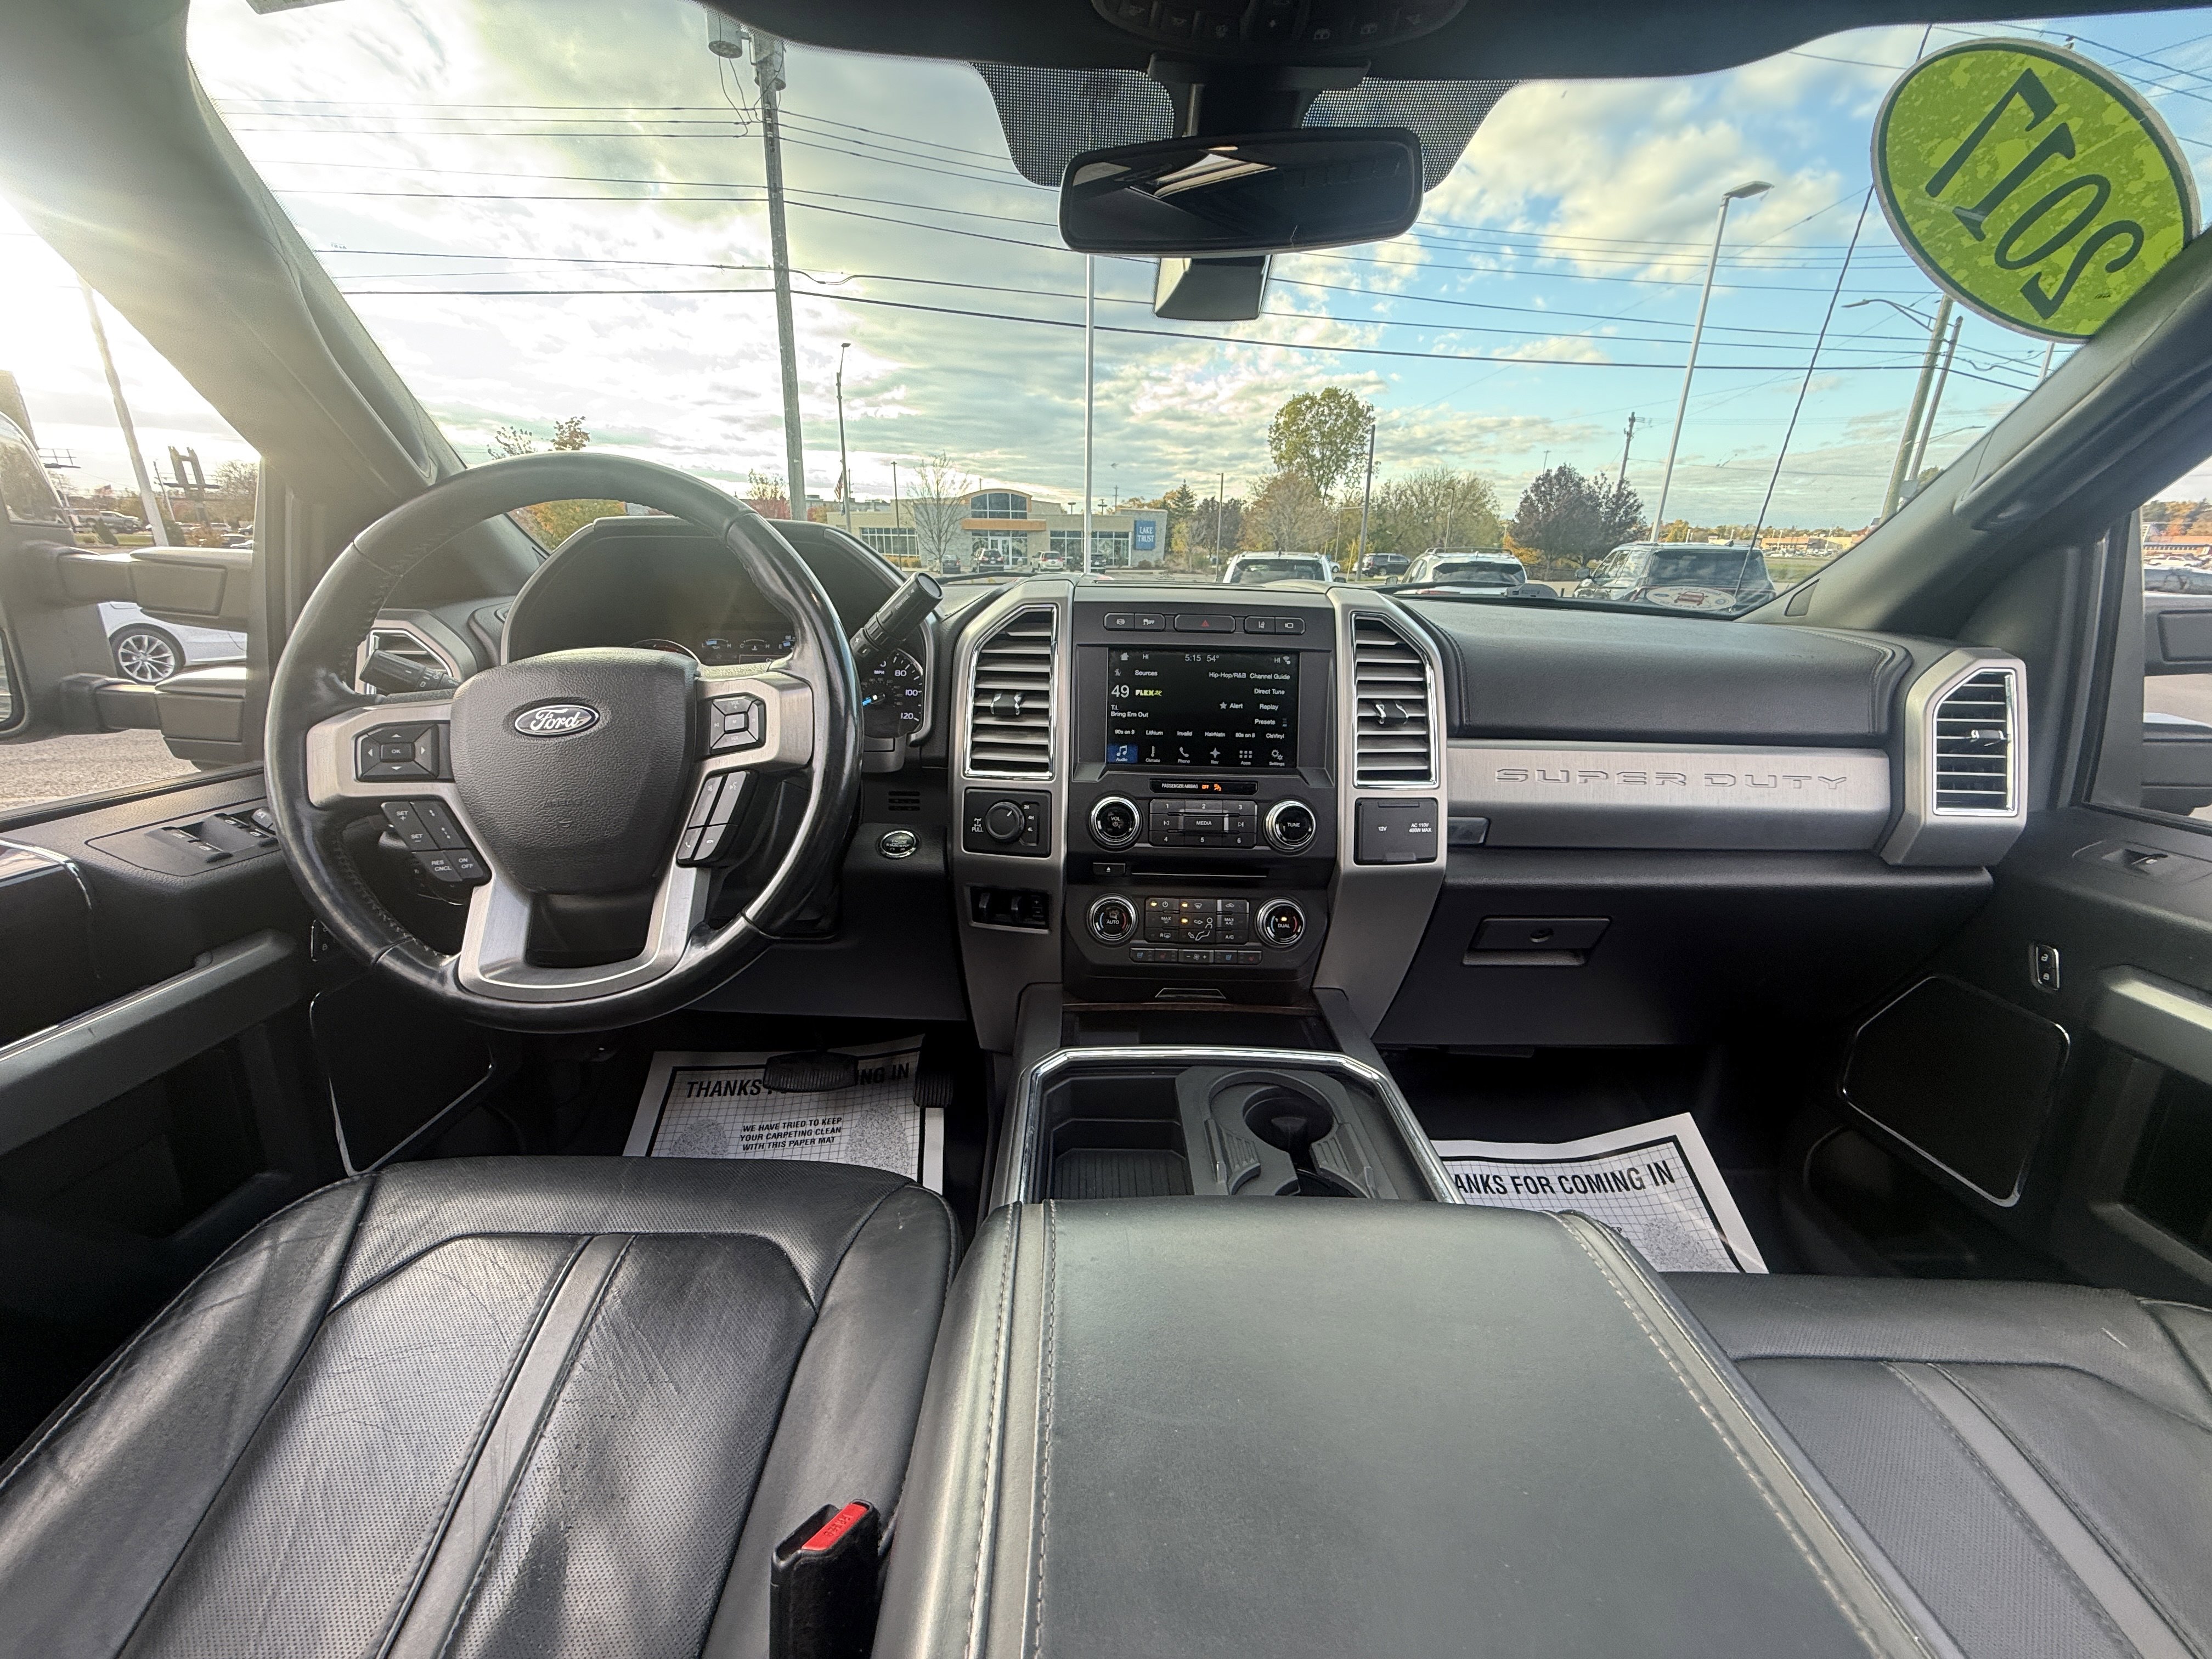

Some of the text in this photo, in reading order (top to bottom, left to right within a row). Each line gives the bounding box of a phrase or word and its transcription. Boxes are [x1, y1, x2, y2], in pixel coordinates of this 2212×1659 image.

[1139, 526, 1153, 534] LAKE
[1137, 534, 1154, 543] TRUST
[1111, 685, 1130, 698] 49
[530, 708, 581, 731] Ford
[1494, 768, 1847, 790] SUPER DUTY
[687, 1079, 762, 1098] THANKS
[891, 1062, 910, 1081] IN
[758, 1122, 780, 1131] HAVE
[782, 1120, 806, 1129] TRIED
[821, 1117, 842, 1126] KEEP
[740, 1126, 842, 1142] YOUR CARPETING CLEAN
[742, 1136, 836, 1151] WITH THIS PAPER MAT
[1510, 1175, 1556, 1195] FOR
[1557, 1167, 1646, 1194] COMING
[1646, 1160, 1675, 1187] IN
